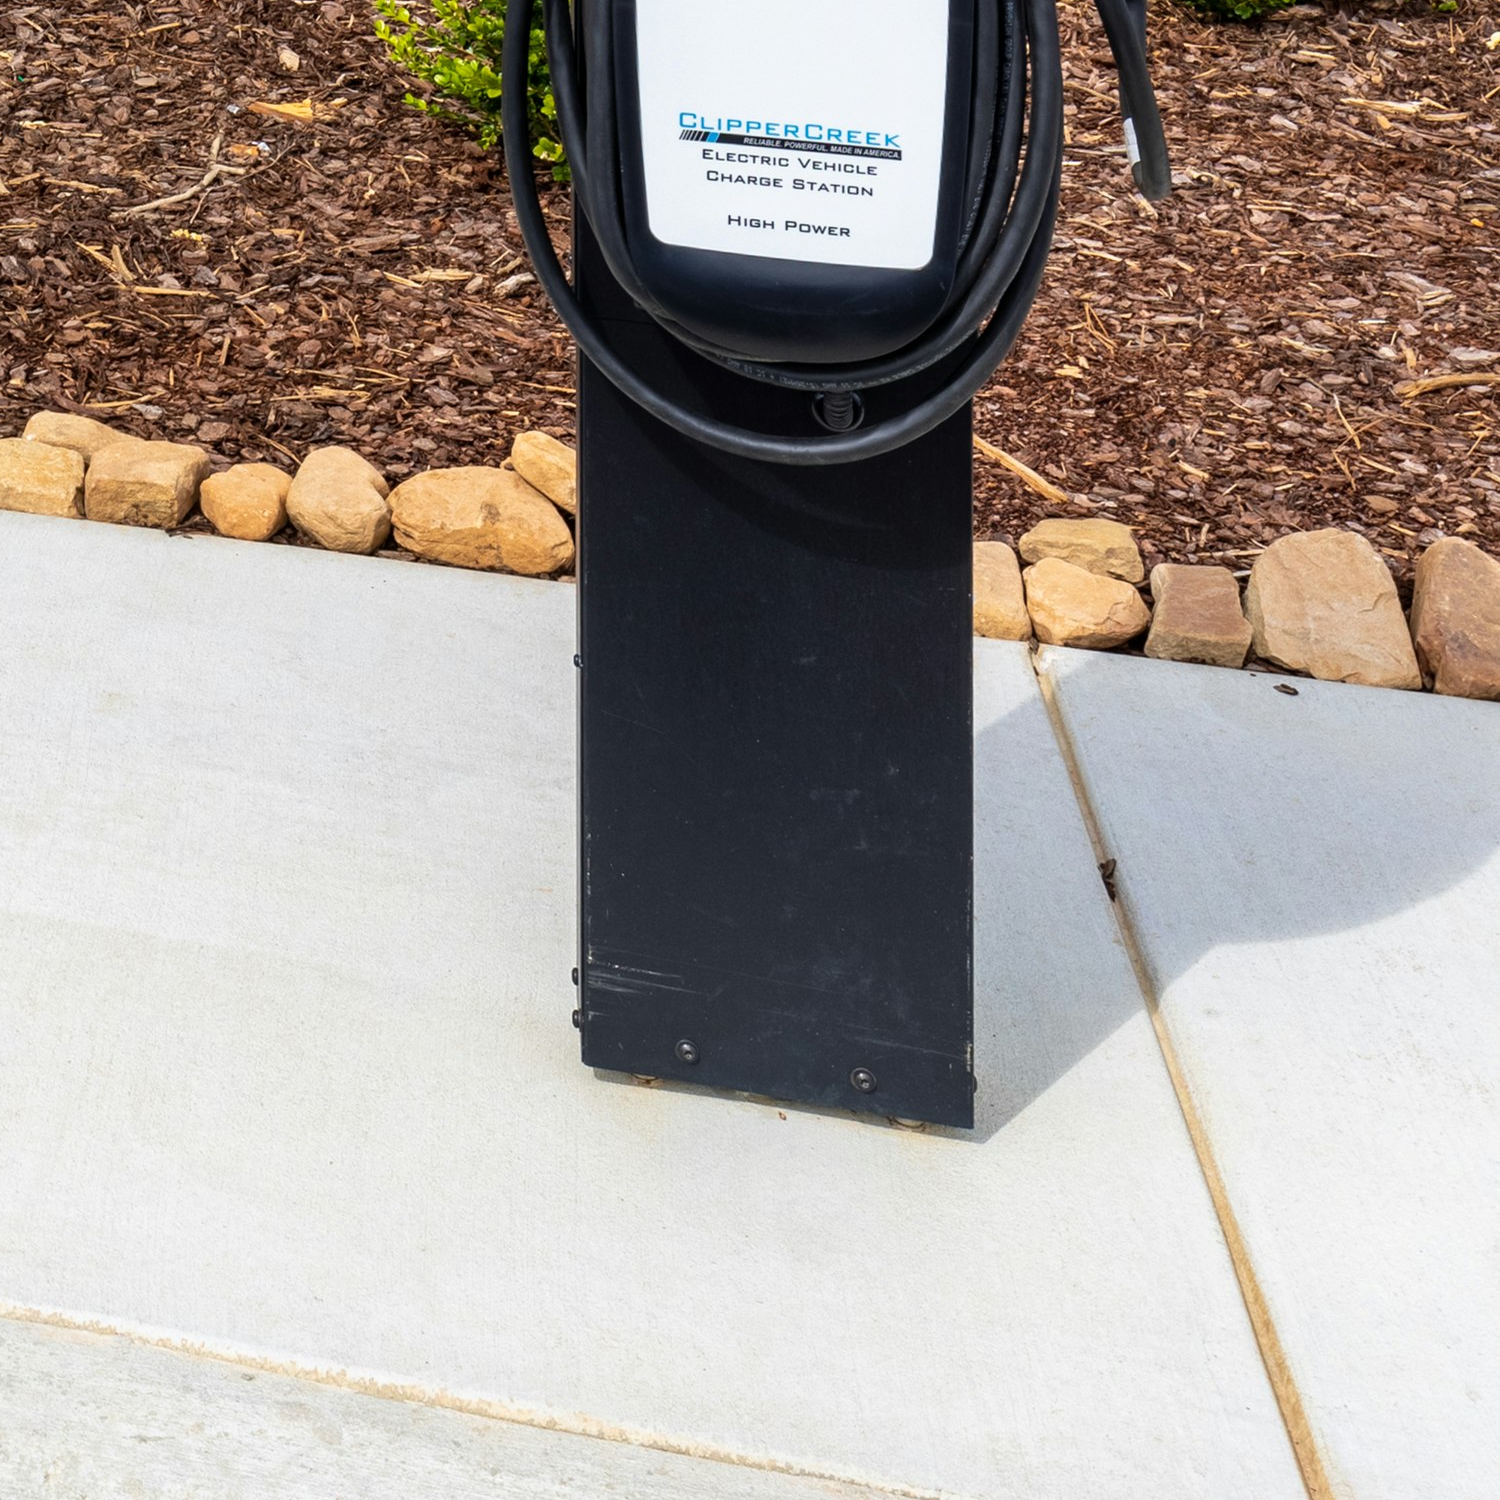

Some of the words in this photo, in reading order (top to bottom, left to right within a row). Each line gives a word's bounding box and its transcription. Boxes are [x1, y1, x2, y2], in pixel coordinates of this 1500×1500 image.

[702, 149, 789, 168] ELECTRIC
[798, 158, 877, 175] VEHICLE
[831, 145, 853, 154] MADE
[853, 147, 862, 155] IN
[706, 170, 783, 188] CHARGE
[792, 179, 873, 196] STATION
[728, 215, 775, 230] HIGH
[785, 220, 850, 237] POWER
